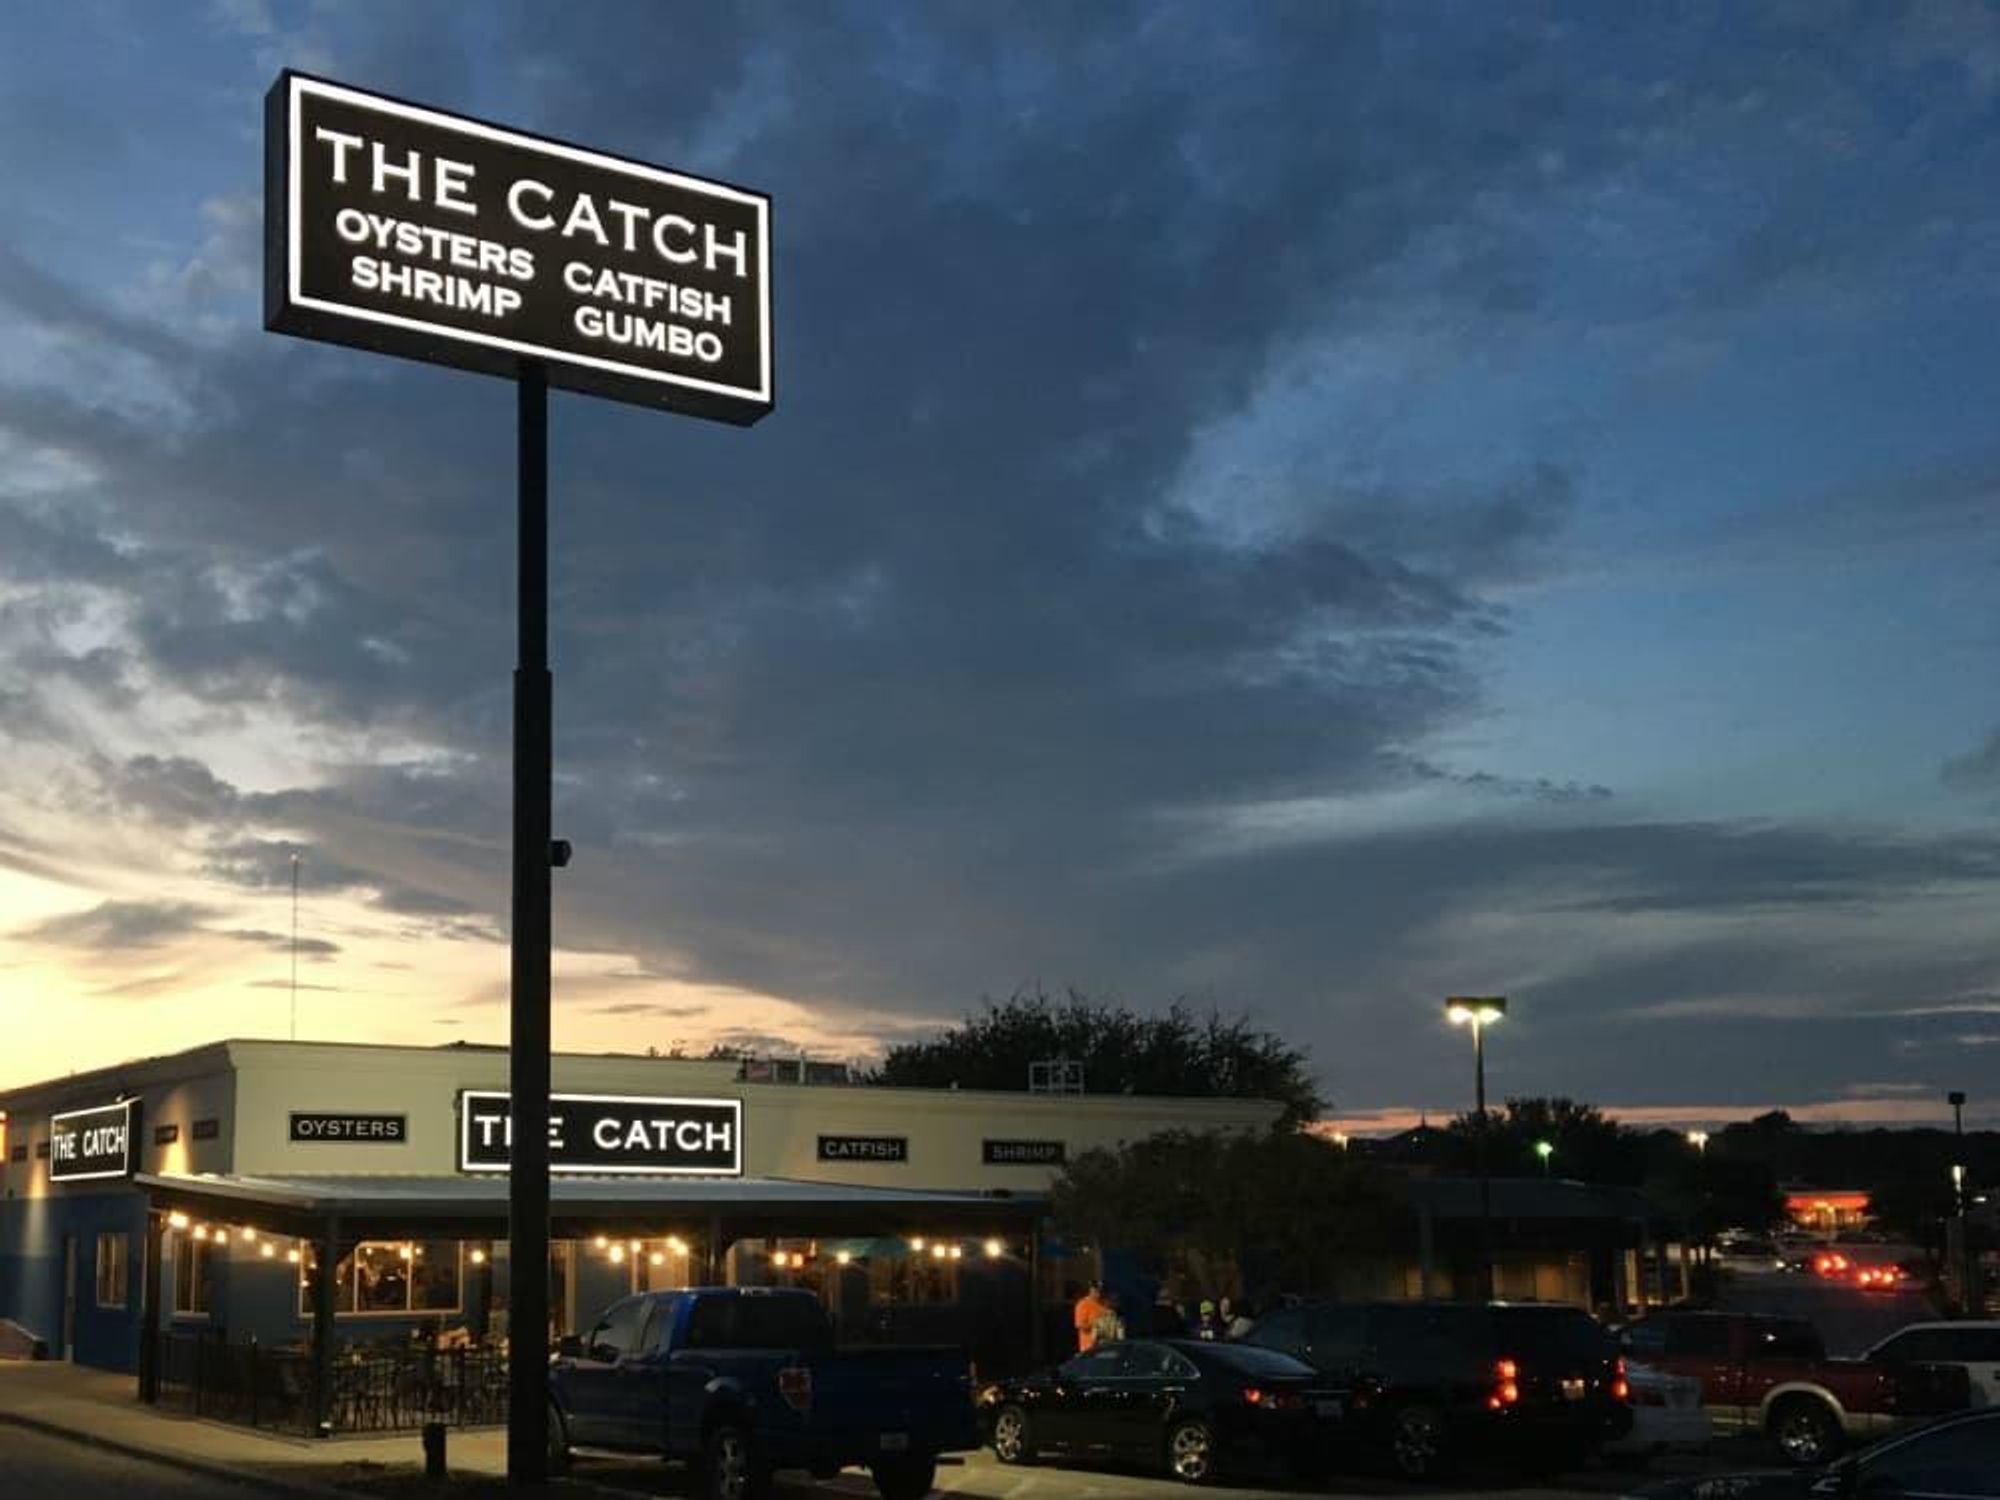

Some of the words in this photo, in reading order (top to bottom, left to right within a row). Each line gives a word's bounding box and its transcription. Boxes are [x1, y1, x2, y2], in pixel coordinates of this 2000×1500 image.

[315, 125, 478, 216] THE
[507, 179, 748, 278] CATCH
[335, 207, 536, 281] OYSTERS
[351, 254, 522, 318] SHRIMP
[563, 261, 732, 325] CATFISH
[574, 305, 724, 363] GUMBO
[53, 1133, 77, 1160] THE
[83, 1125, 126, 1158] CATCH
[296, 1119, 401, 1138] OYSTERS
[474, 1114, 564, 1149] TE
[593, 1118, 732, 1152] CATCH
[825, 1140, 901, 1158] CATFISH
